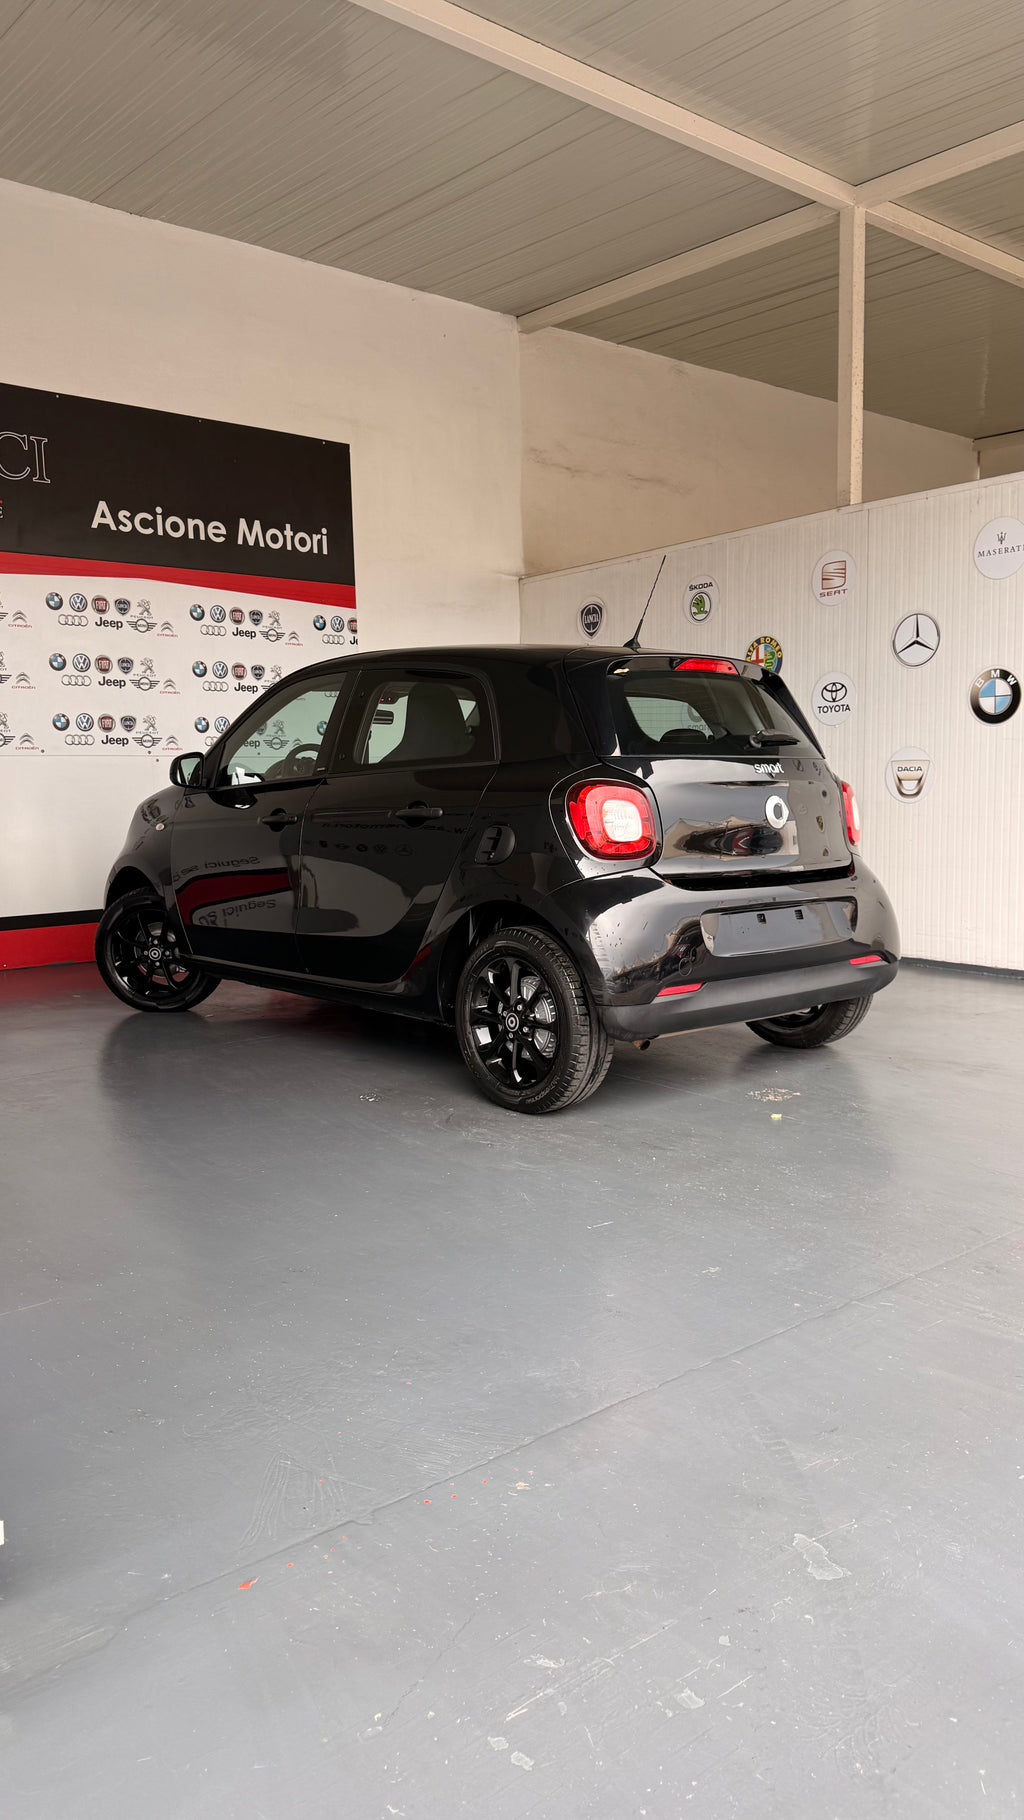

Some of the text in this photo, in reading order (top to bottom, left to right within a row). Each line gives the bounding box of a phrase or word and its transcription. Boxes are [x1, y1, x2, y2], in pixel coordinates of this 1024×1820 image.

[91, 500, 328, 555] Ascione Motori
[688, 581, 714, 592] ŠKODA
[819, 588, 848, 598] SEAT
[95, 616, 124, 630] Jeep
[232, 627, 257, 639] Jeep
[760, 637, 783, 659] ROMEO
[98, 676, 126, 689] Jeep
[975, 669, 1018, 689] BMW
[234, 682, 259, 694] Jeep
[817, 703, 851, 714] TOYOTA
[101, 735, 129, 747] Jeep
[244, 740, 261, 749] eep
[754, 762, 785, 774] smart
